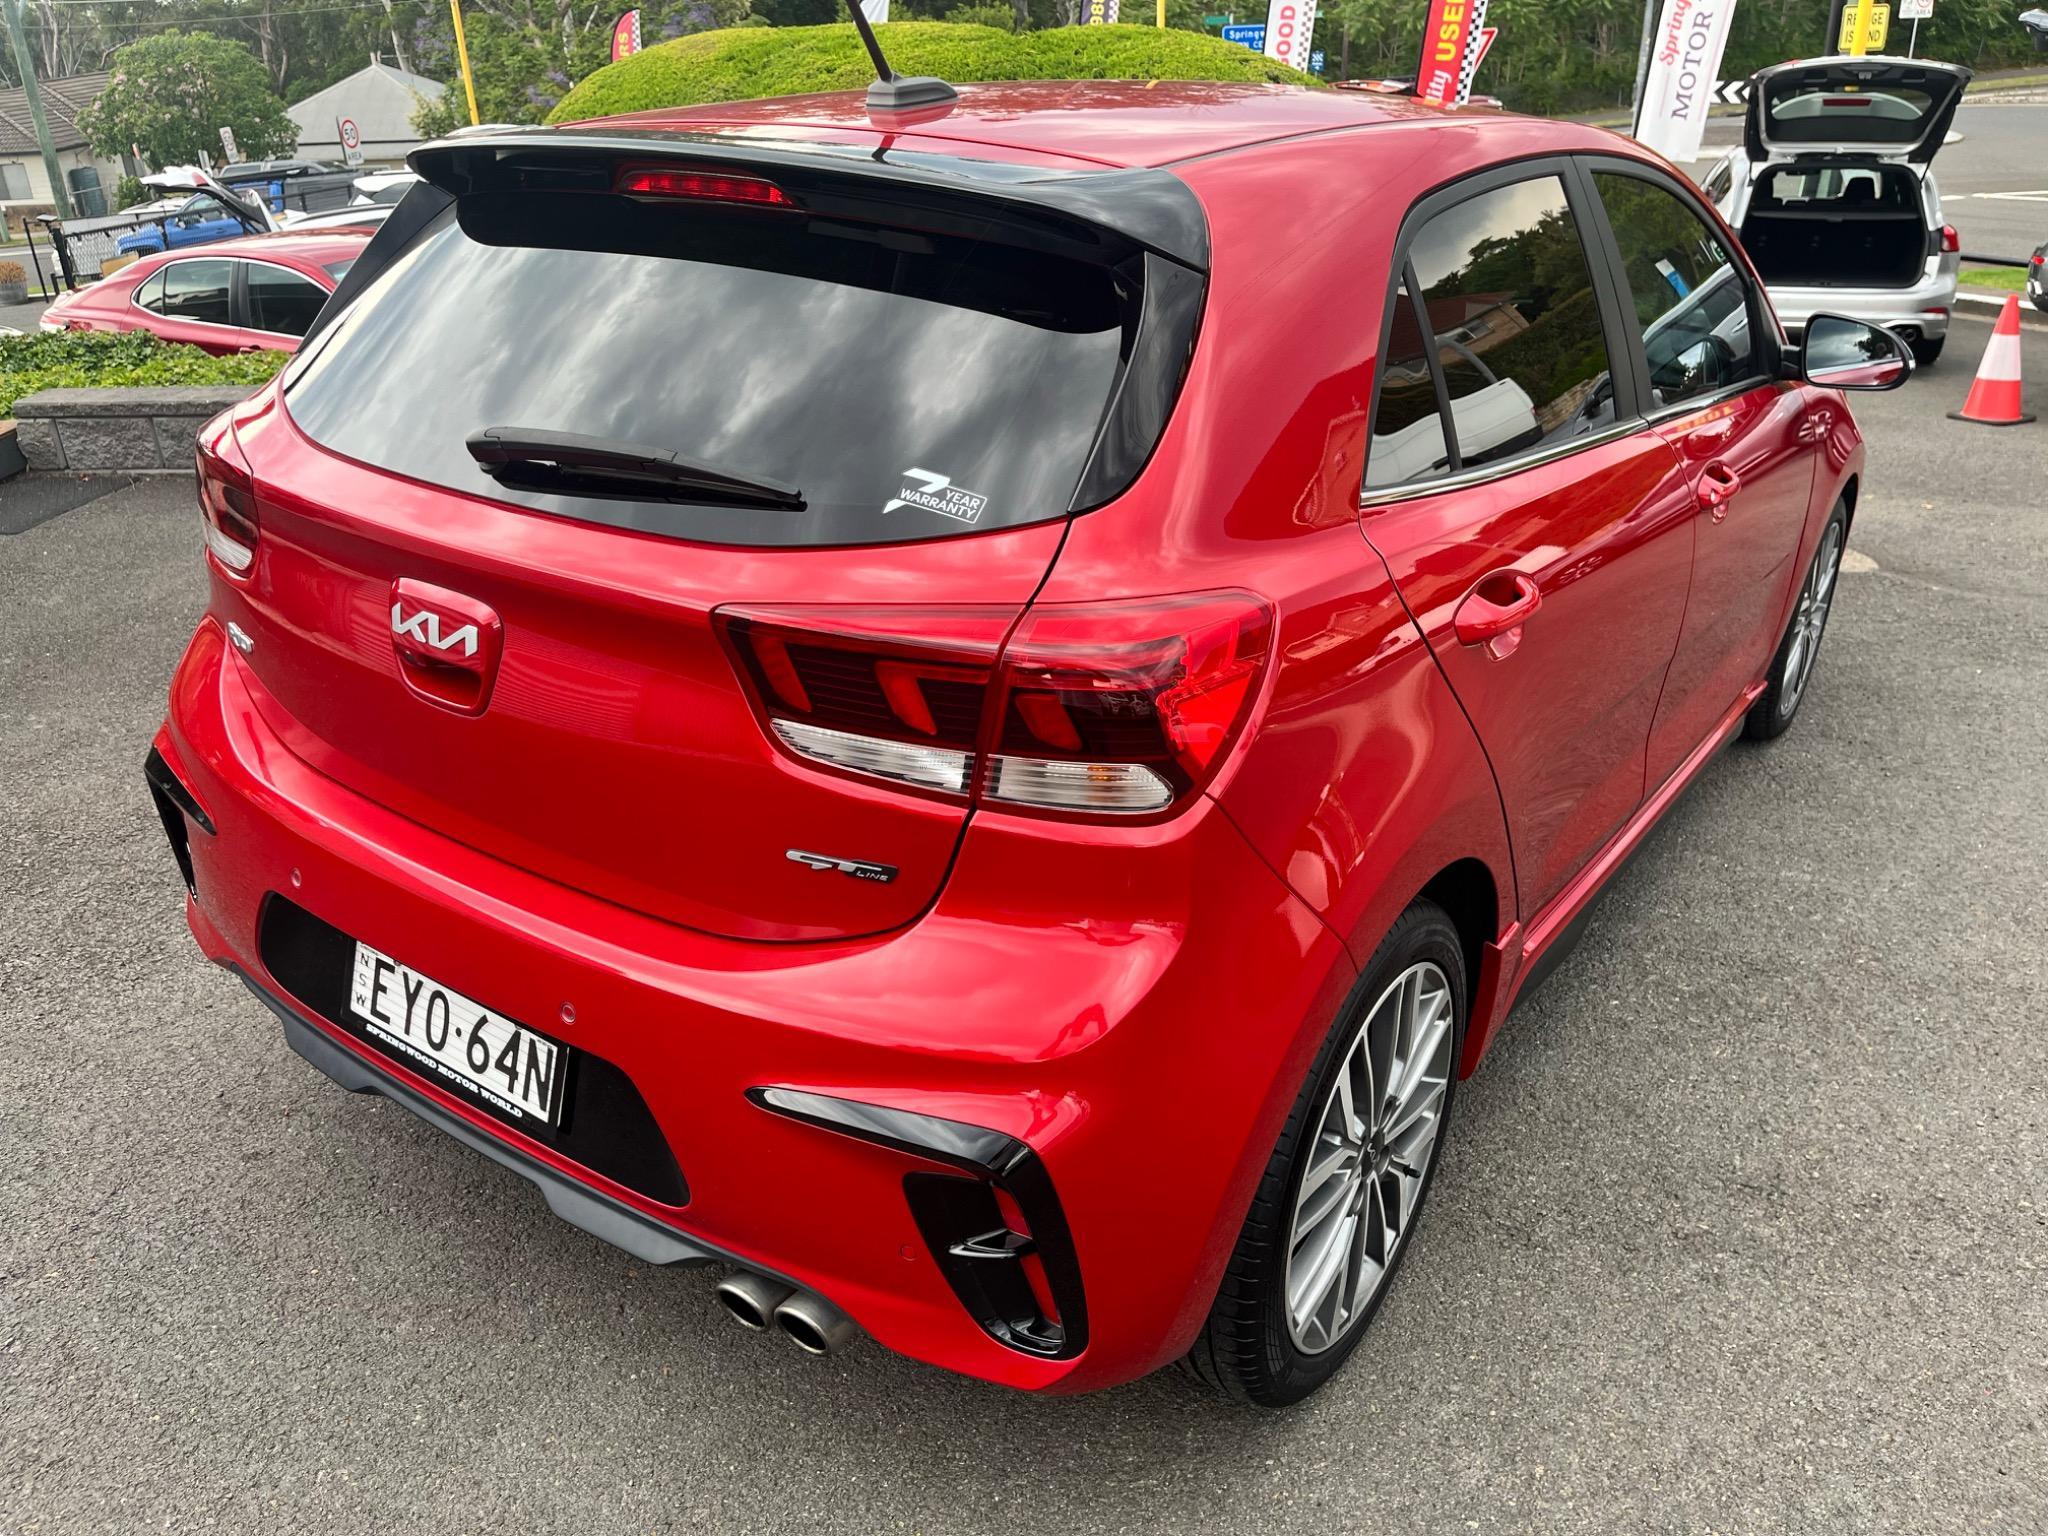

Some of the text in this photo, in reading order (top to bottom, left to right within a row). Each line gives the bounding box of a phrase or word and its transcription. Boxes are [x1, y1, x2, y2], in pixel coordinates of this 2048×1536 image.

[1671, 11, 1714, 121] MOTOR
[344, 127, 356, 141] 50
[900, 488, 977, 519] WARRANTY
[945, 489, 981, 510] YEAR
[391, 602, 479, 657] KIA
[856, 870, 889, 882] LINE
[366, 1023, 523, 1119] SPRINGWOOD MOTOR WORLD
